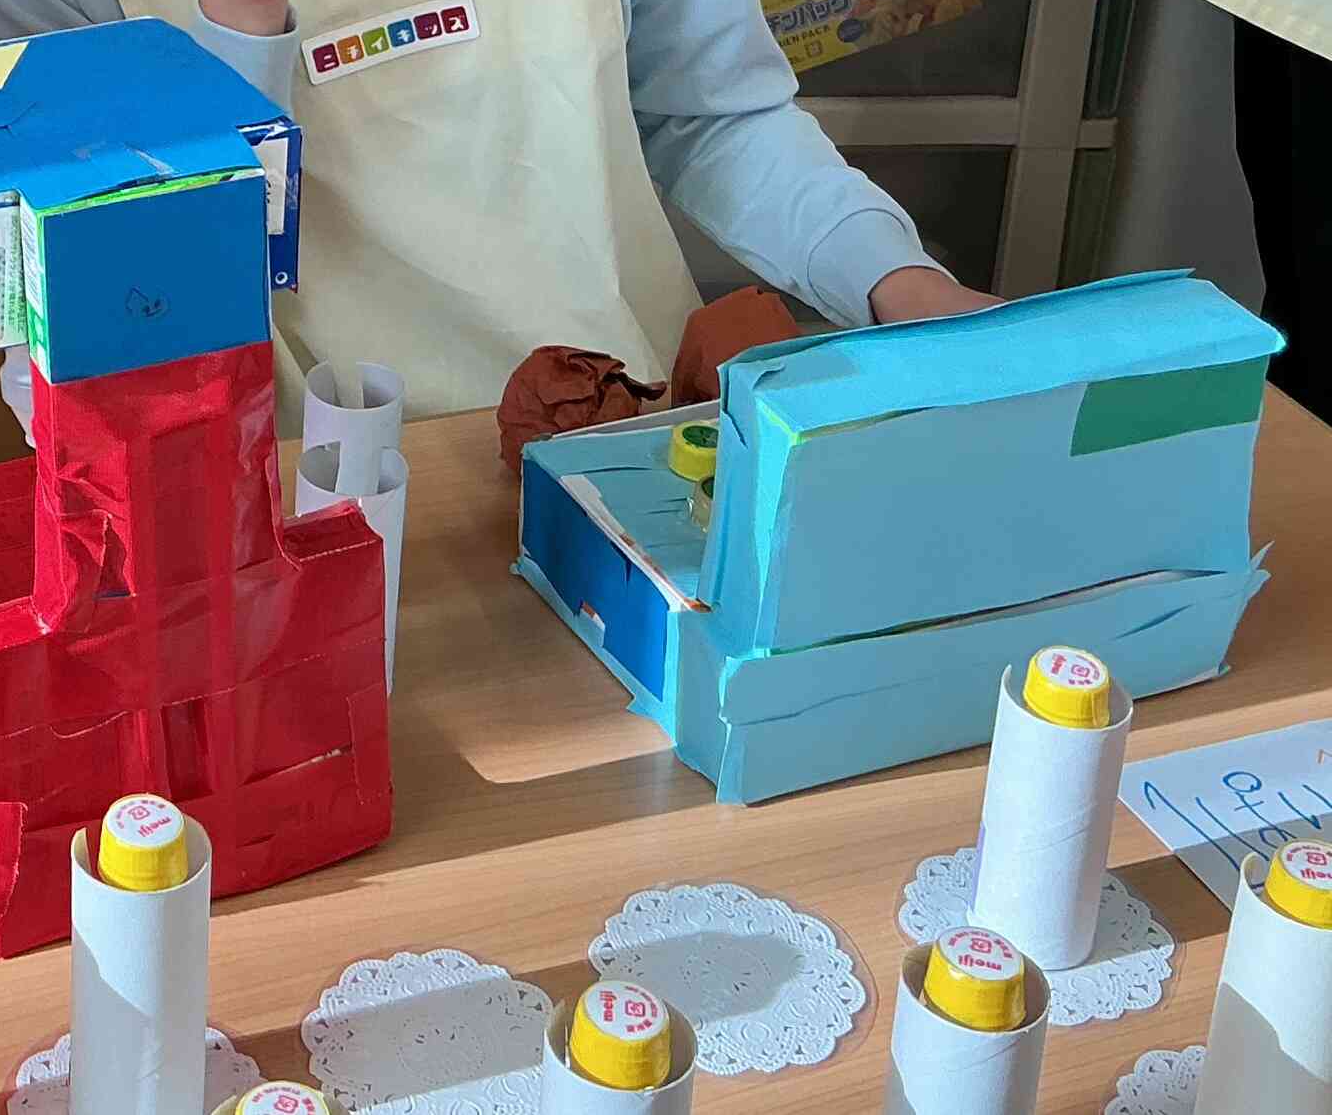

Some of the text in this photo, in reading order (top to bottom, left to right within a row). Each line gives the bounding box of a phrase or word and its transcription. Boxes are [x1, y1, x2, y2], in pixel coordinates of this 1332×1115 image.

[319, 11, 466, 71] ニチイキッズ
[135, 814, 173, 838] meiji
[957, 953, 1003, 972] meiji
[599, 989, 619, 1023] meiji
